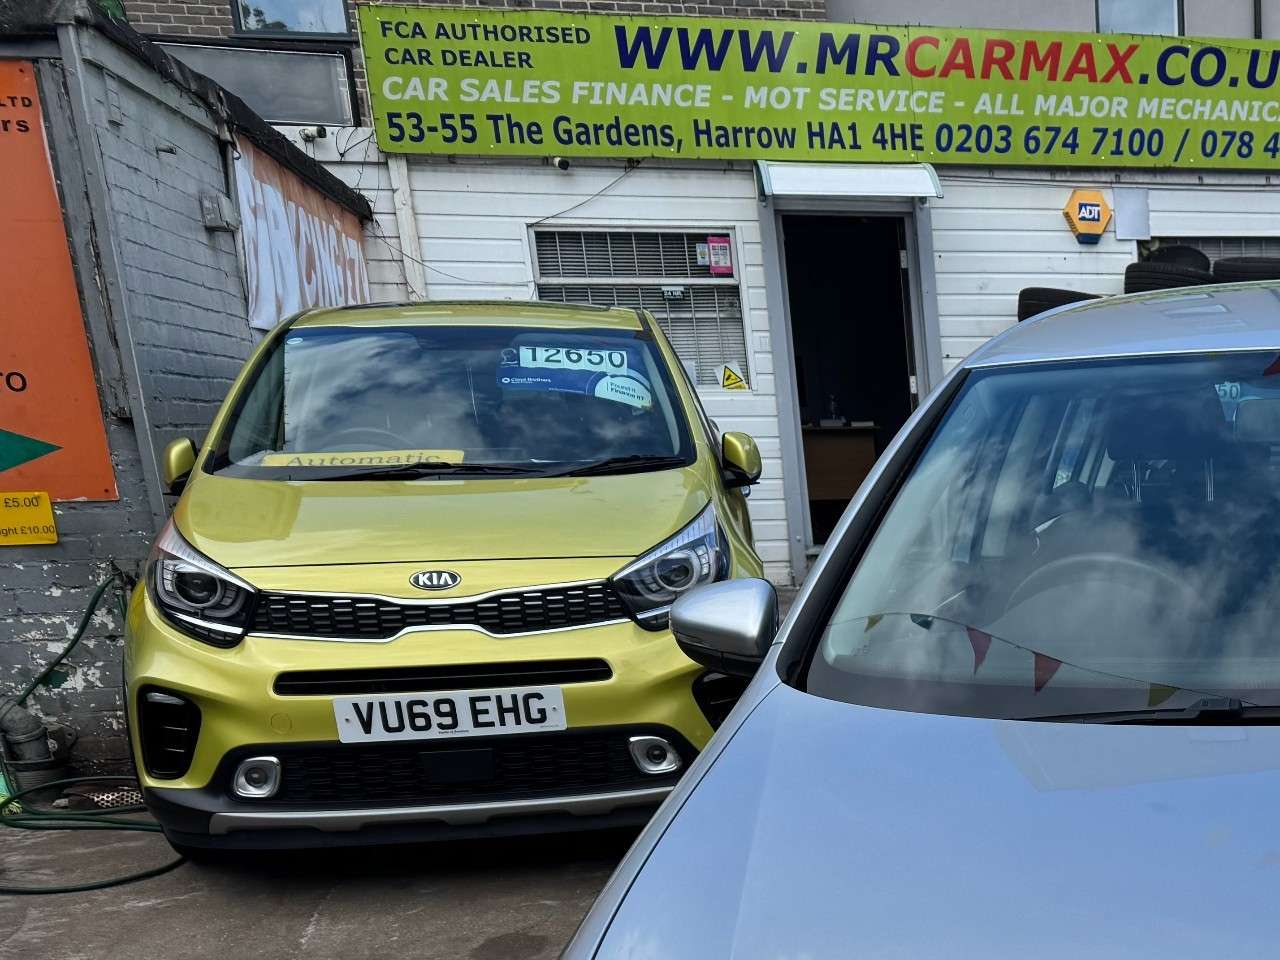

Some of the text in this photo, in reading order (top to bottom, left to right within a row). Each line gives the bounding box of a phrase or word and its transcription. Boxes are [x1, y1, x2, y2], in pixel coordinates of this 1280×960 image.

[381, 21, 591, 45] FCA AUTHORISED
[384, 48, 534, 69] CAR DEALER
[382, 77, 449, 101] CAR
[458, 79, 561, 104] SALES
[571, 81, 712, 108] FINANCE
[744, 86, 811, 110] MOT
[818, 88, 945, 114] SERVICE
[973, 92, 1024, 116] ALL
[1034, 94, 1128, 119] MAJOR
[387, 112, 478, 144] 53-55
[486, 113, 544, 145] The
[552, 115, 684, 154] Gardens,
[693, 119, 797, 150] Harrow
[806, 120, 861, 151] HA1
[871, 121, 924, 152] 4HE
[934, 123, 1012, 155] 0203
[1023, 125, 1079, 156] 674
[1092, 127, 1164, 158] 7100
[1173, 128, 1191, 162] /
[1200, 129, 1254, 160] 078
[1078, 205, 1100, 219] ADT
[0, 371, 28, 392] O
[286, 450, 442, 467] Automatic
[418, 573, 454, 586] KIA
[351, 691, 548, 735] VU69 EHG
